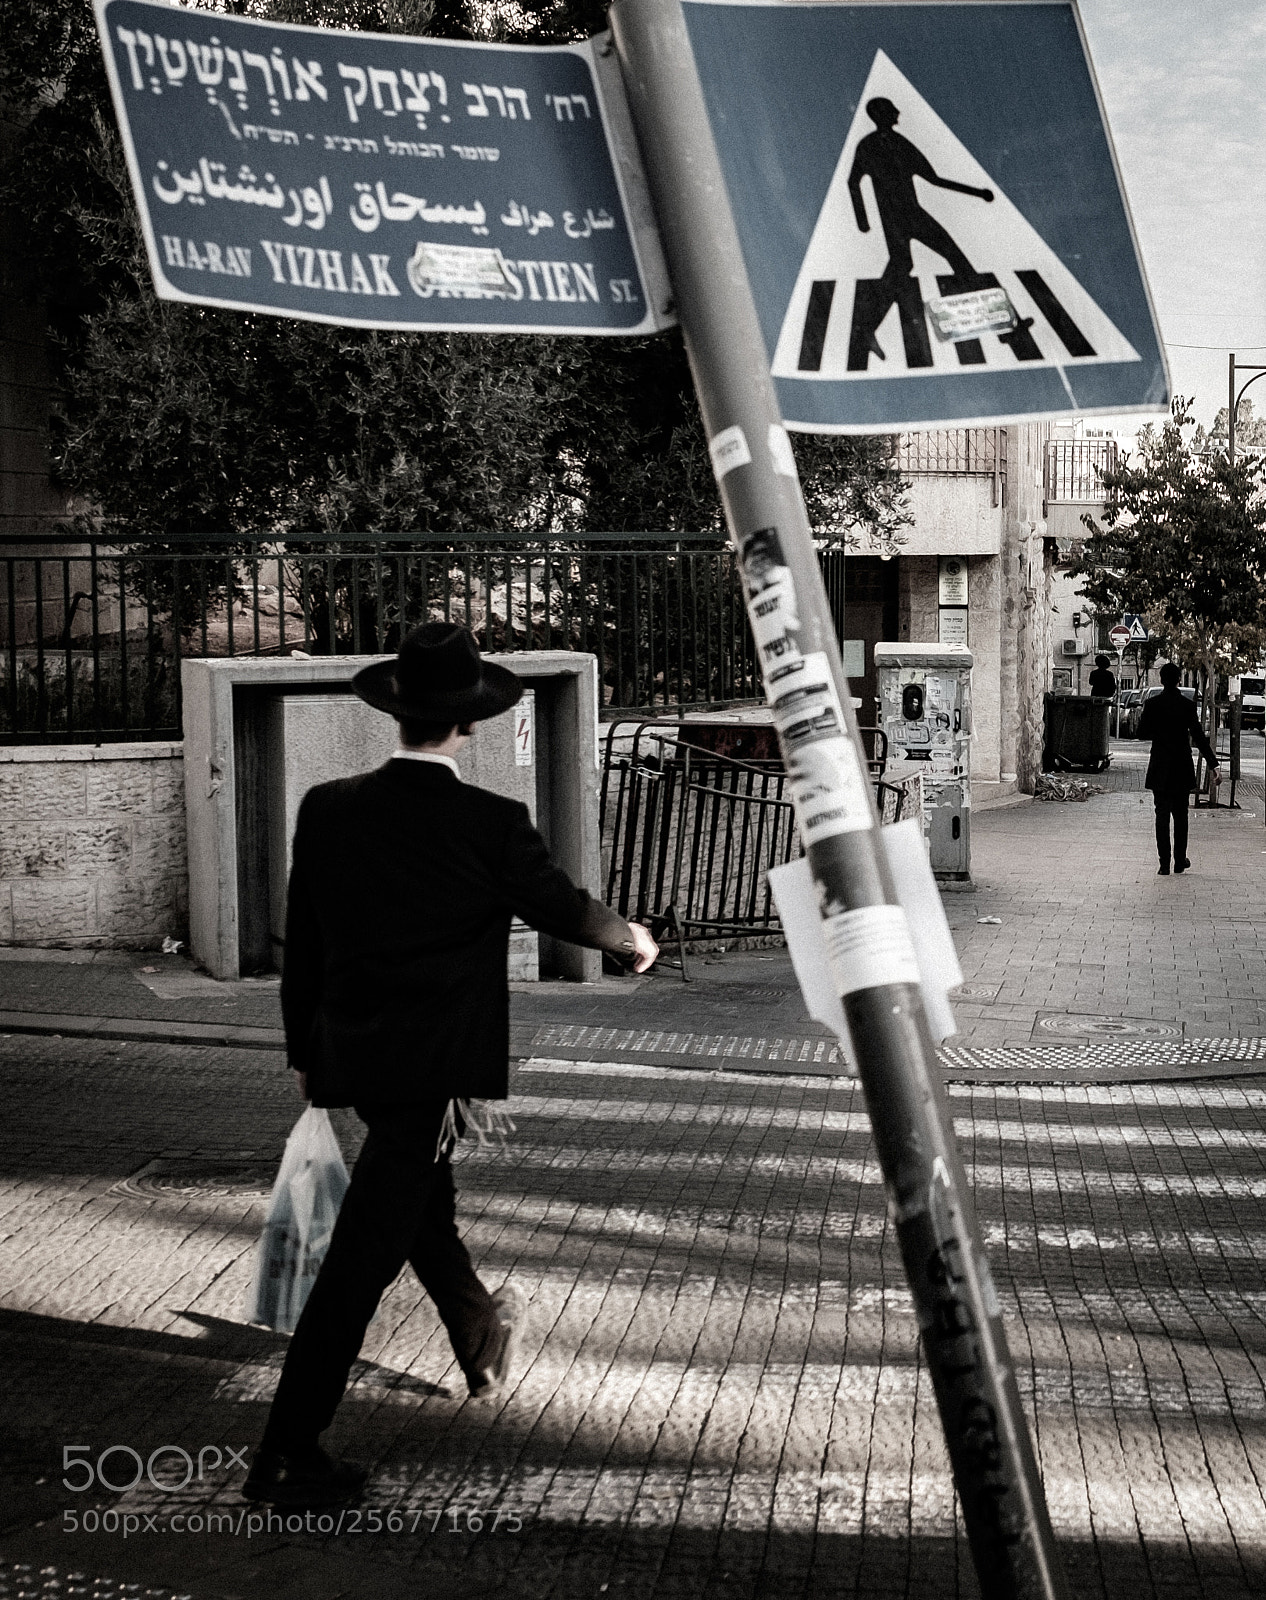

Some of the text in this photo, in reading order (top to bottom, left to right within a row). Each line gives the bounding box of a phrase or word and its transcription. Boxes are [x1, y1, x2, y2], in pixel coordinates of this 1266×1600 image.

[462, 82, 531, 120] הרב
[383, 135, 445, 159] הכותל
[161, 234, 252, 278] HA-RAV
[260, 239, 402, 297] YIZHAK
